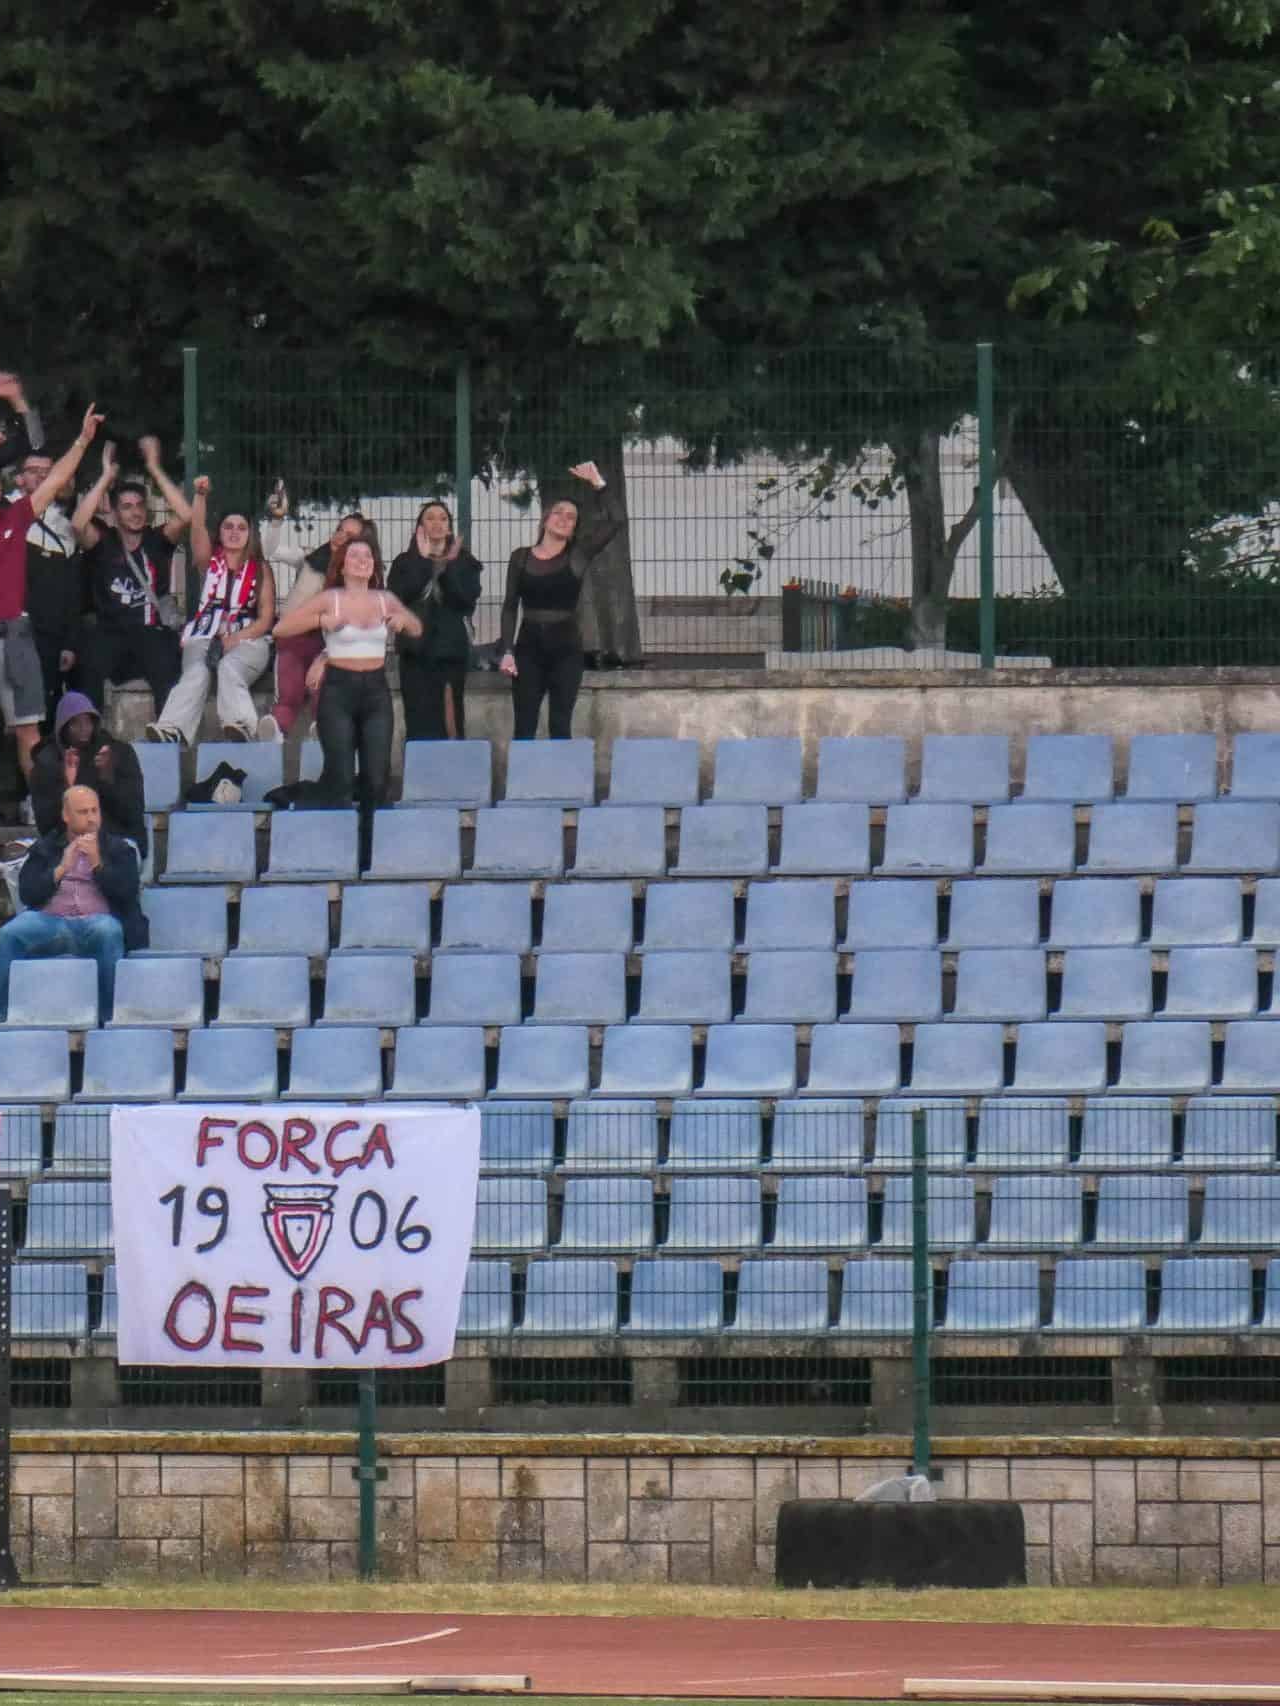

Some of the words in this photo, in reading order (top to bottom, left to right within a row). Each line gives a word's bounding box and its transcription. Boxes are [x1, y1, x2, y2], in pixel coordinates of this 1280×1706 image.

[196, 1116, 394, 1178] FORÇA
[159, 1183, 230, 1254] 19
[348, 1189, 432, 1254] 06
[163, 1279, 424, 1359] OEIRAS
